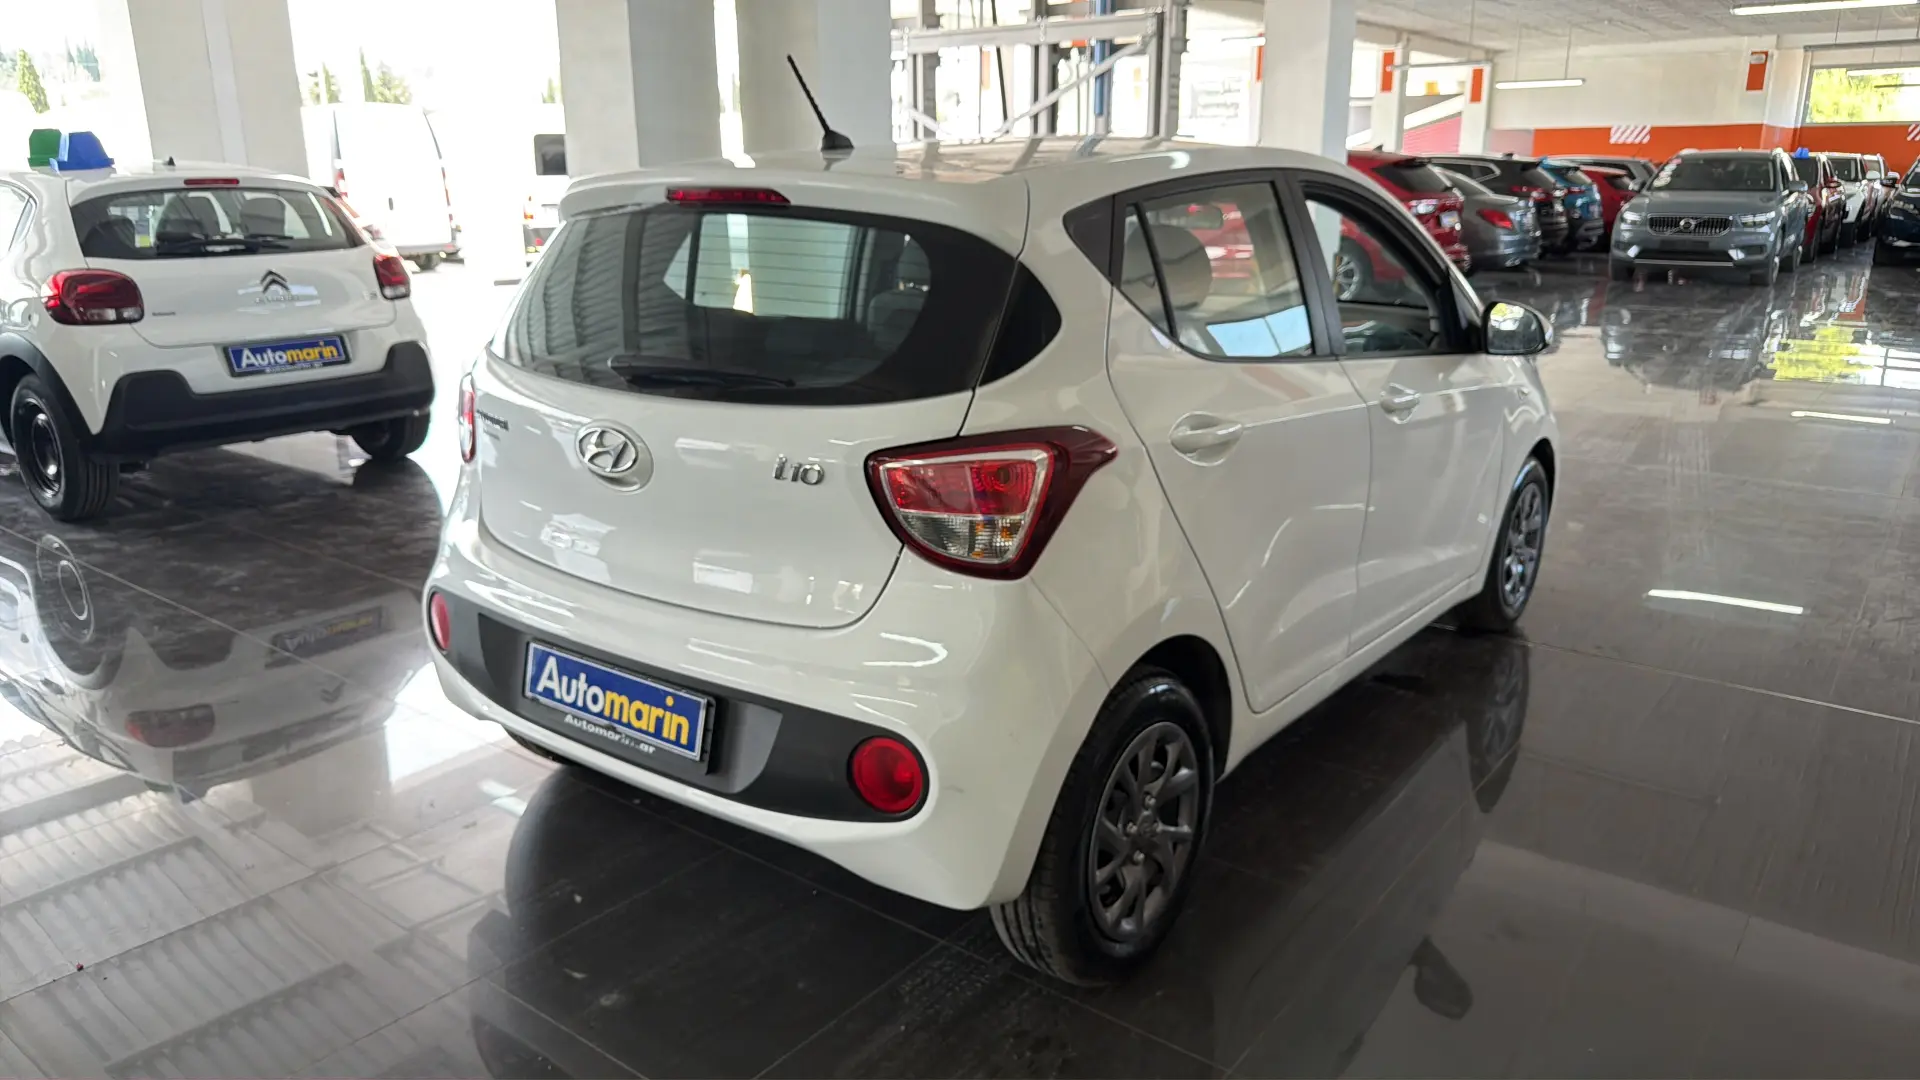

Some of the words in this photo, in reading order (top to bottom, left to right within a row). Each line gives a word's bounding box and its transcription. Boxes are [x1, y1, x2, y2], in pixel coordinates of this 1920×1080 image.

[241, 341, 338, 368] Automarin
[773, 453, 825, 486] i10
[536, 655, 689, 745] Automarin
